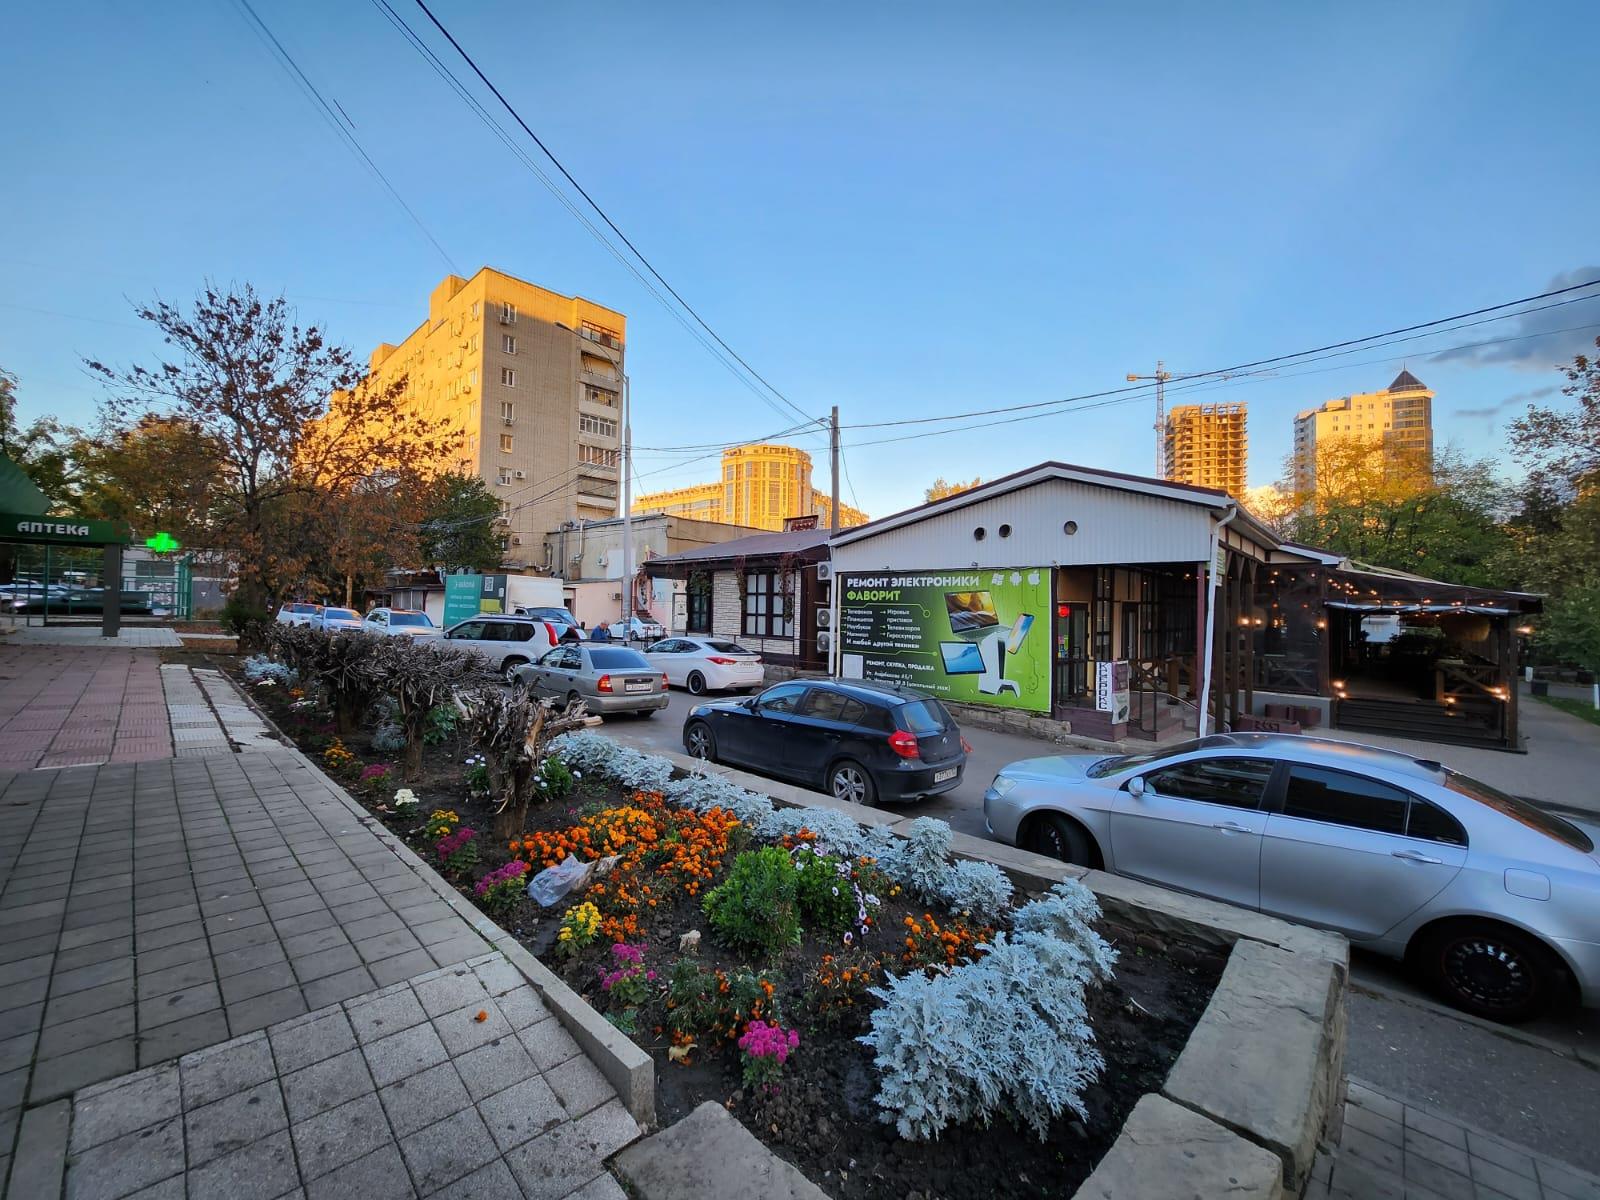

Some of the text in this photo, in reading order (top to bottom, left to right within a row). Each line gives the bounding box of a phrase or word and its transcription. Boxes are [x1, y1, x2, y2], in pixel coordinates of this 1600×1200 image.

[17, 521, 89, 536] АПТЕКА
[847, 576, 980, 587] РЕМОНТ ЭЛЕКТРОНИКИ
[847, 590, 901, 600] ФАВОРИТ
[907, 663, 935, 671] ПРОДАЖА
